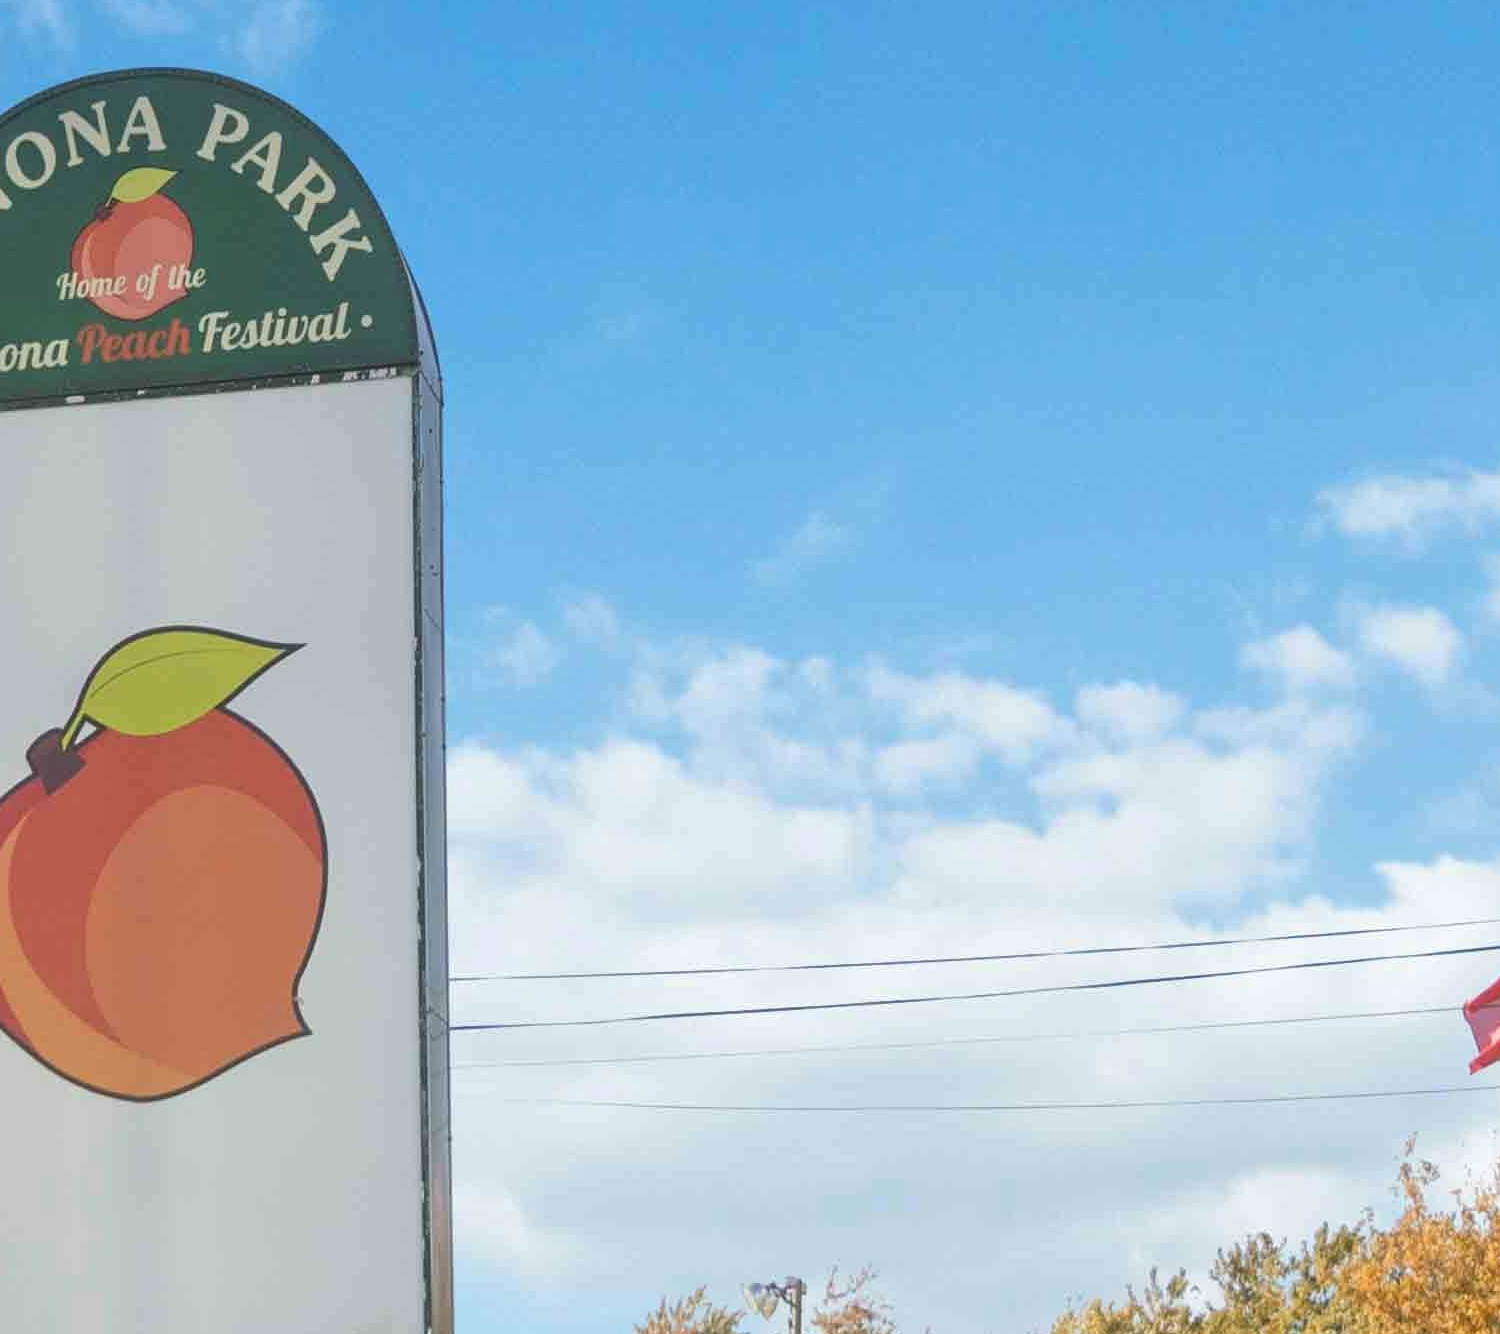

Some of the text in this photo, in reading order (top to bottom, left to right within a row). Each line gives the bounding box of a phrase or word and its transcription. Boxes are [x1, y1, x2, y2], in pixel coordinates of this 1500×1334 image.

[196, 103, 373, 283] PARK
[55, 262, 206, 302] Home of the
[76, 318, 192, 365] Peach
[198, 301, 352, 354] Festival
